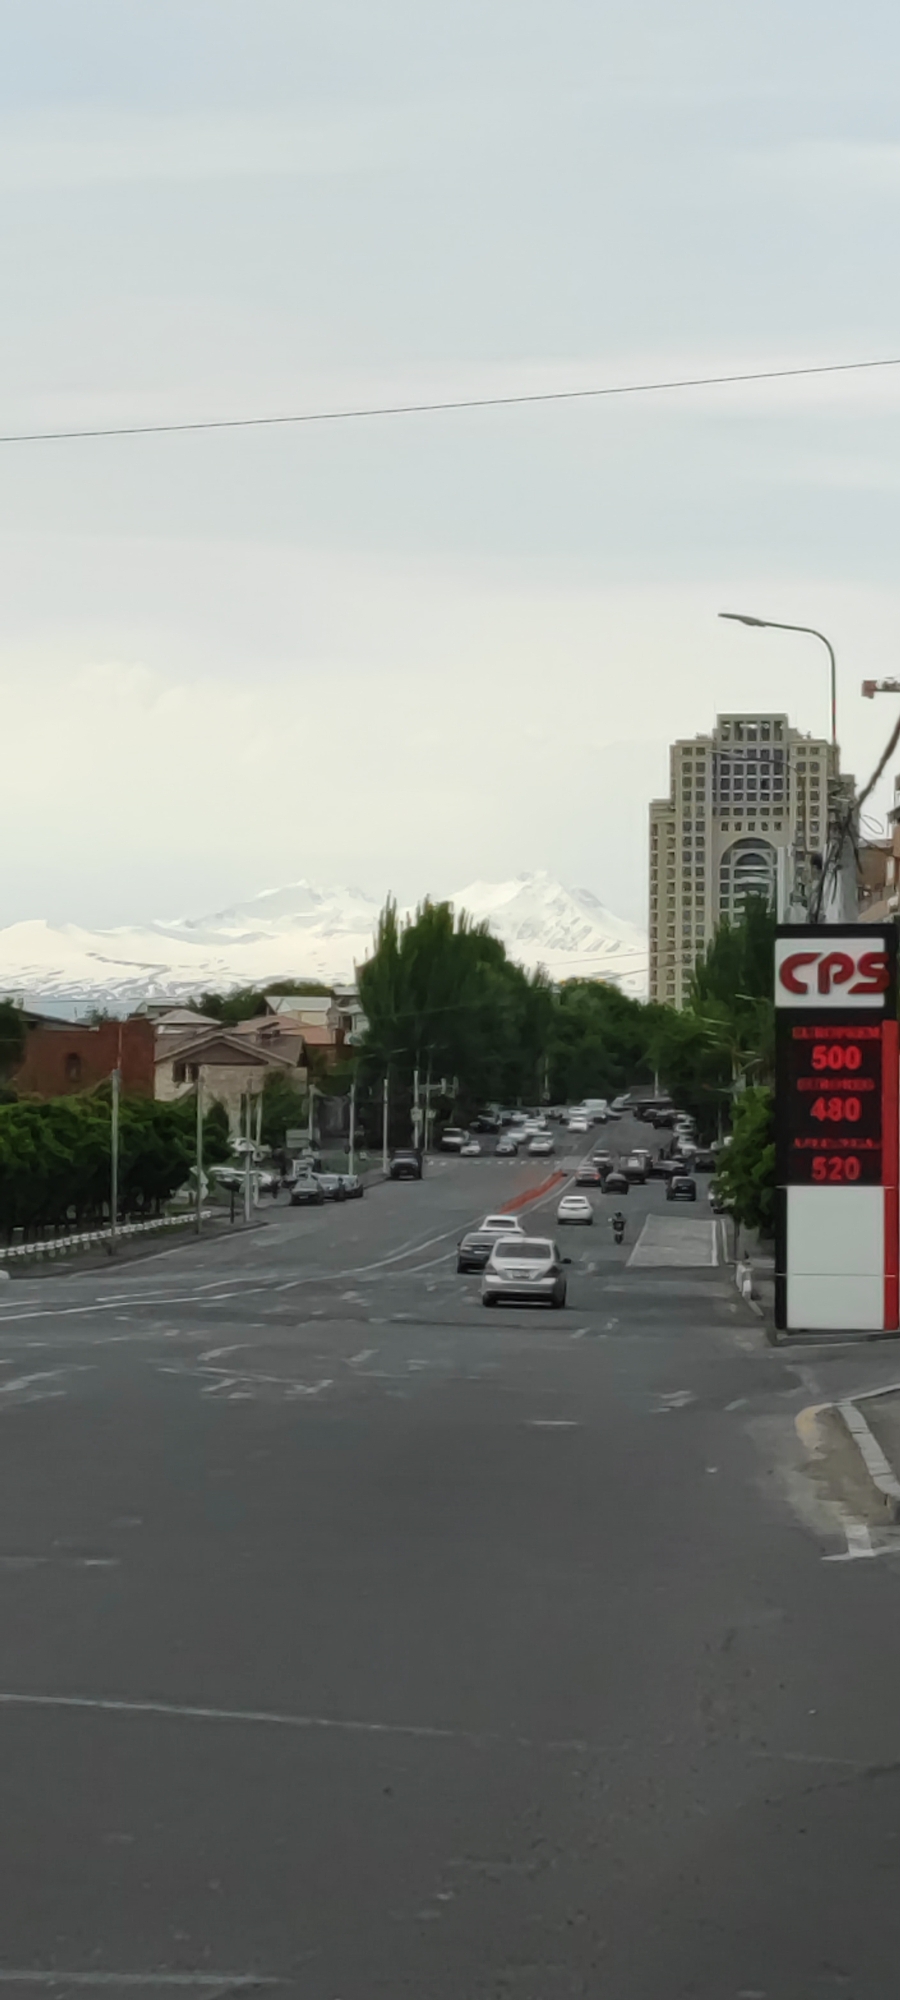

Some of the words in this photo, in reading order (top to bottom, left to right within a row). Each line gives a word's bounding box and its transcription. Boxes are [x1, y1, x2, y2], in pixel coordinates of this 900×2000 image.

[779, 952, 890, 994] CPS
[812, 1044, 862, 1070] 500
[811, 1096, 861, 1122] 480
[812, 1156, 861, 1182] 520
